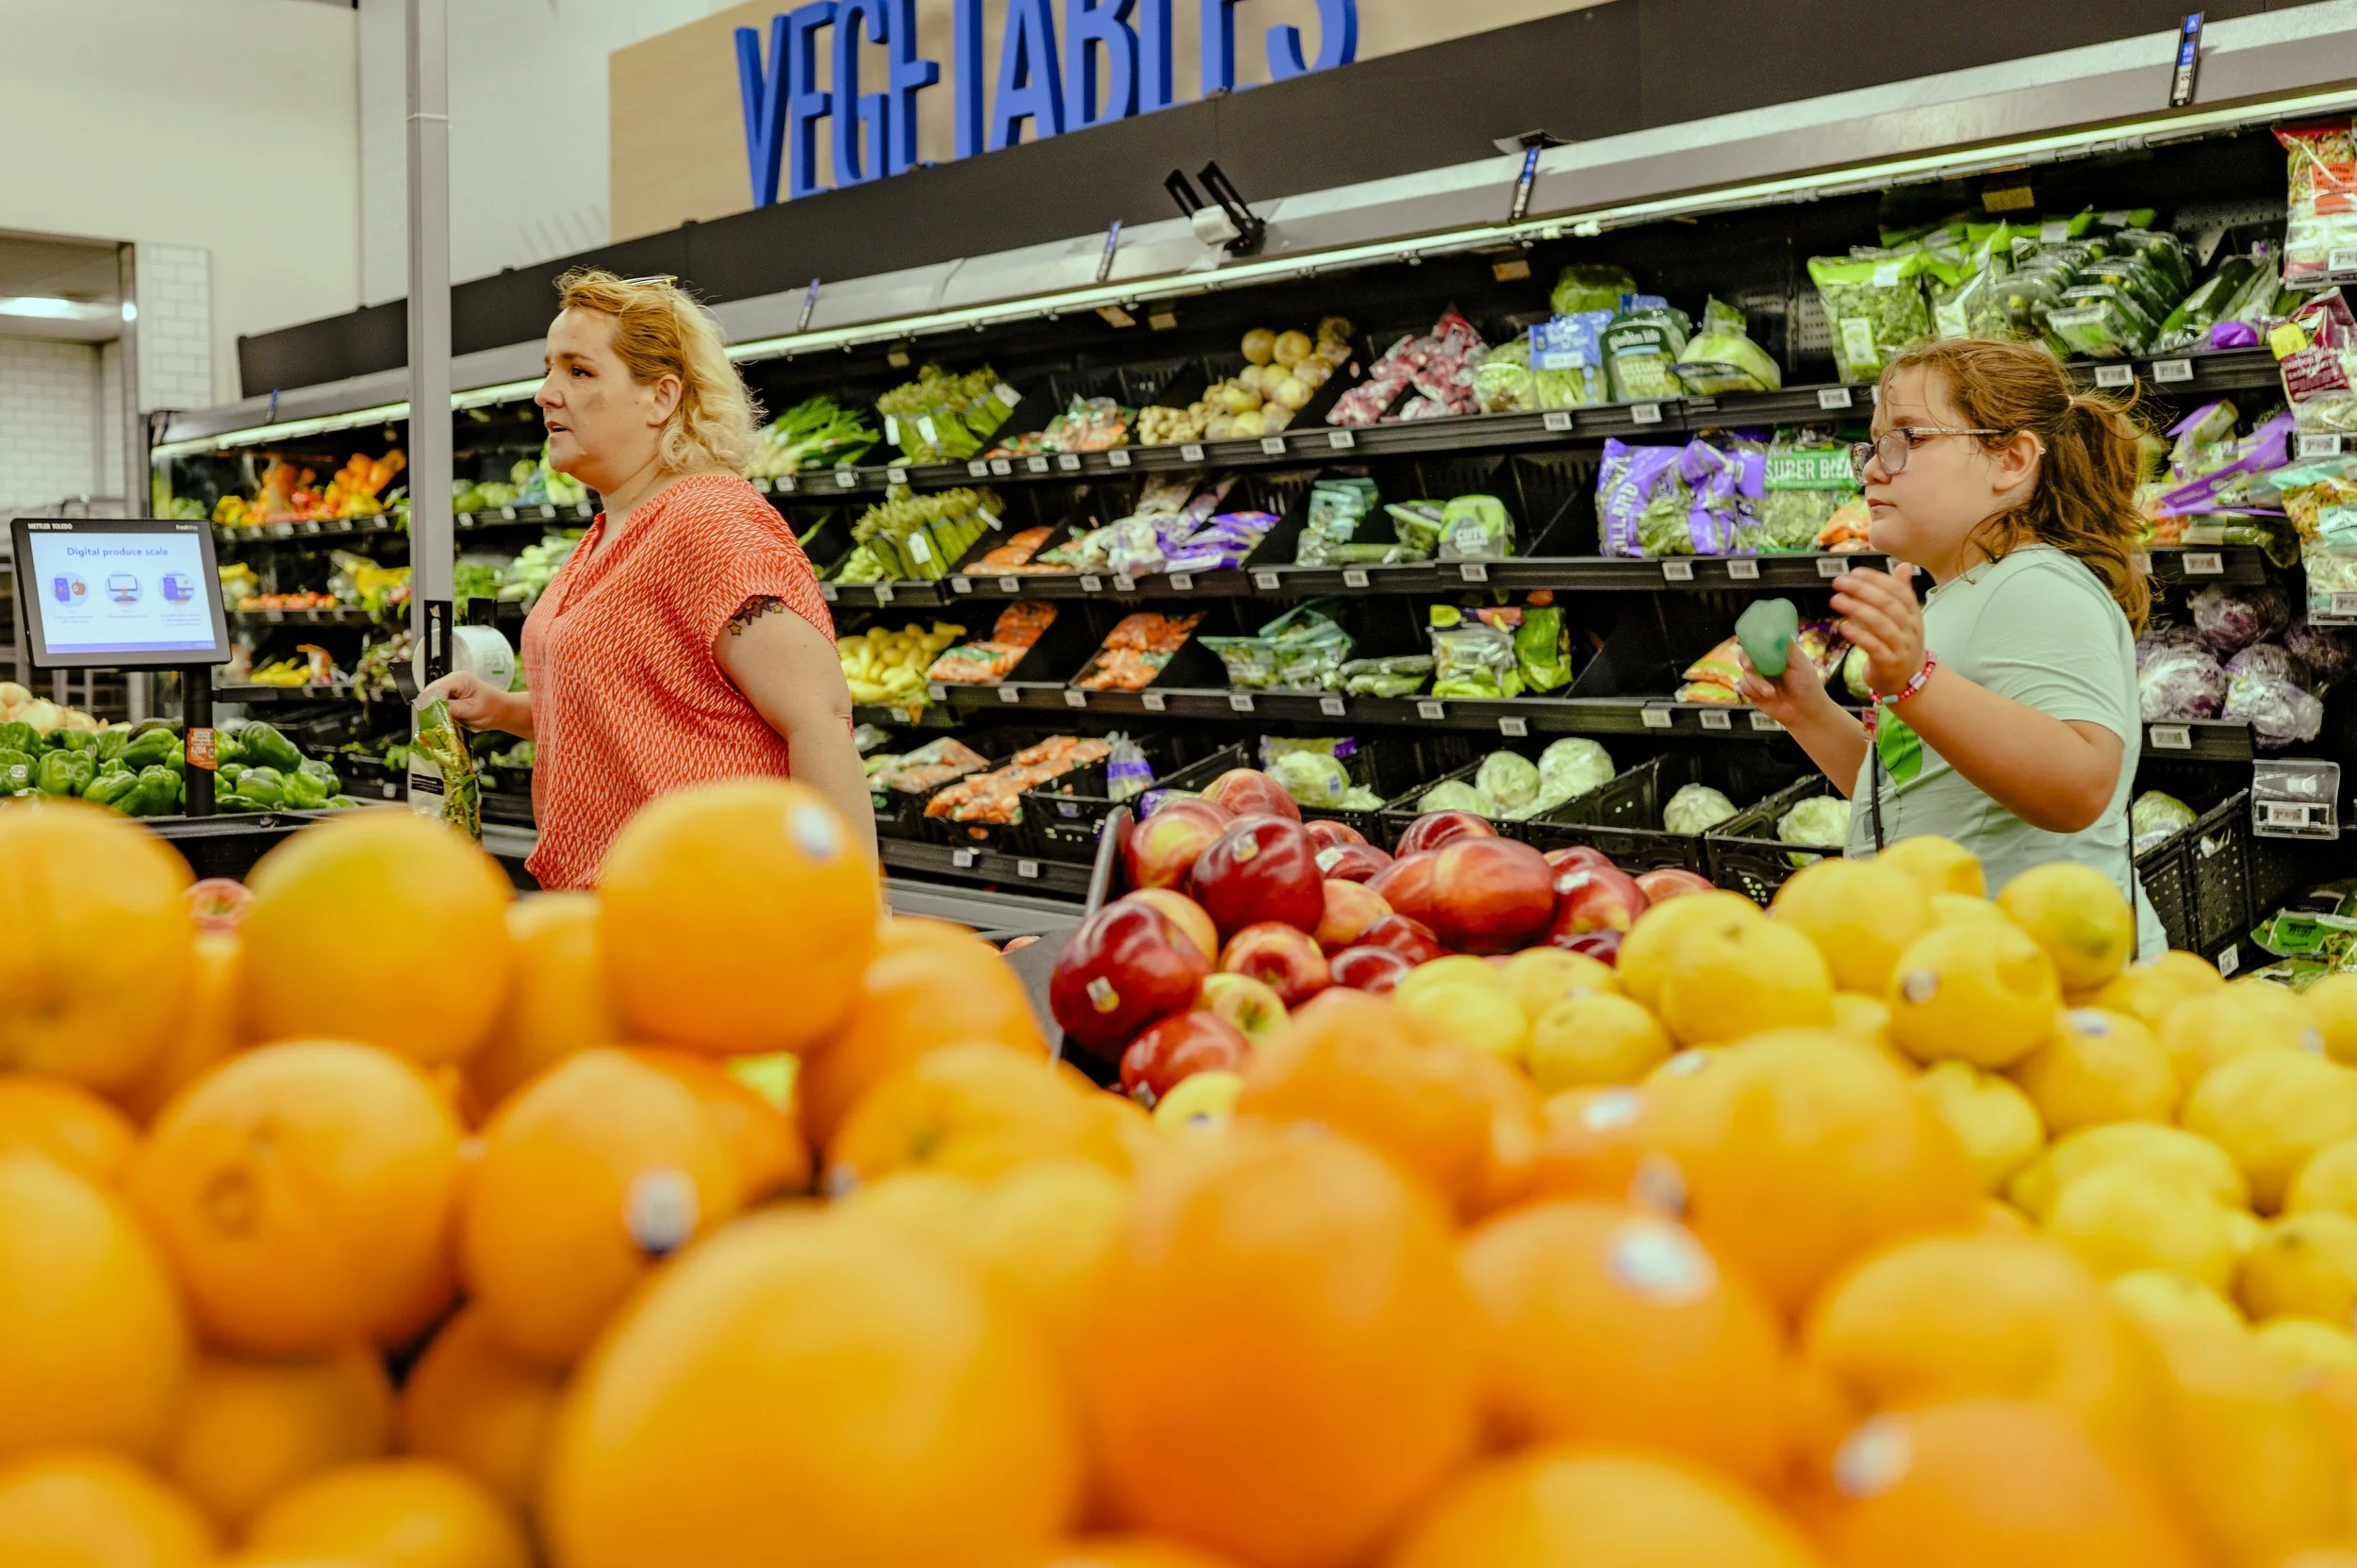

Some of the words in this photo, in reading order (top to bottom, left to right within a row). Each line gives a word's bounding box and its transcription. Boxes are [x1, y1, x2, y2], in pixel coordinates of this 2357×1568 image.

[1765, 457, 1815, 481] SUPER
[67, 546, 100, 557] Digital
[103, 547, 142, 558] produce
[145, 546, 169, 556] scale
